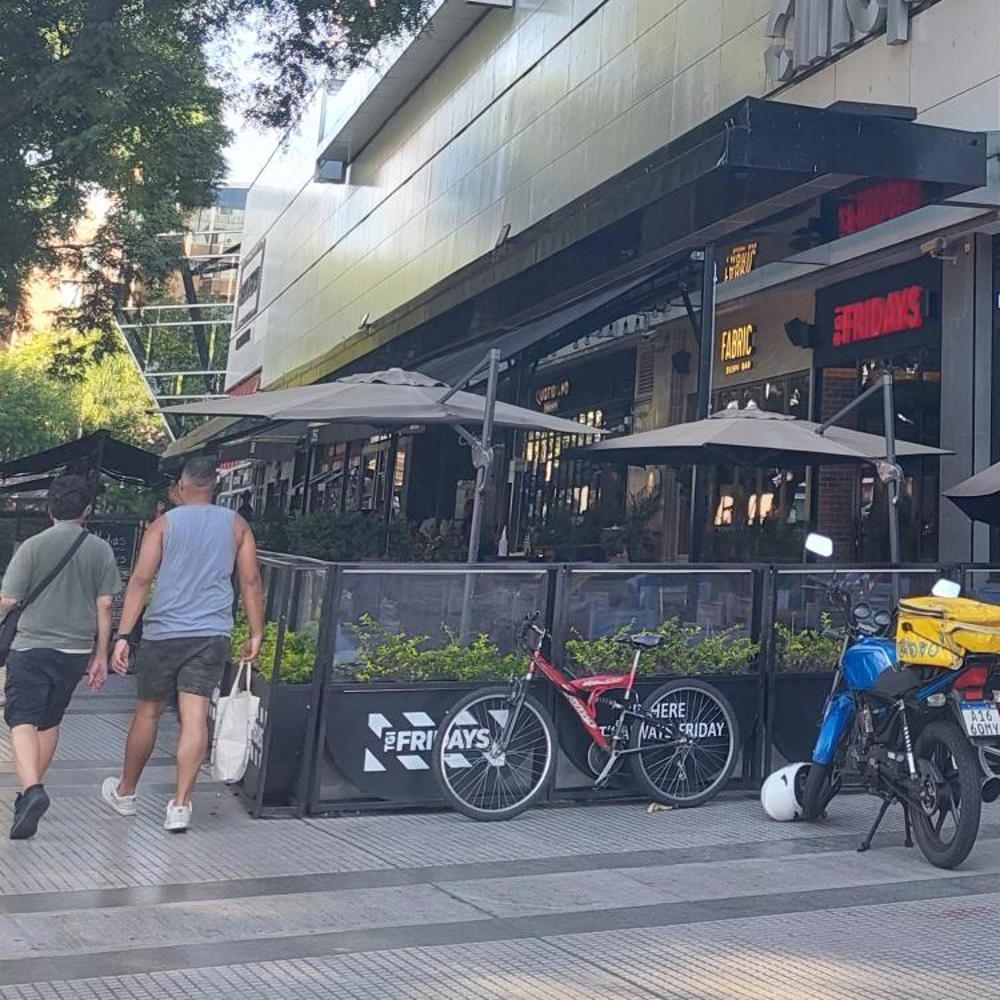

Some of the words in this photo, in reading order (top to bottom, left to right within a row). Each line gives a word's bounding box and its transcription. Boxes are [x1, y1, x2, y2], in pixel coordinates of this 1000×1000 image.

[720, 323, 754, 362] FABRIC
[384, 731, 397, 752] TGI
[396, 728, 491, 752] FRIAYS
